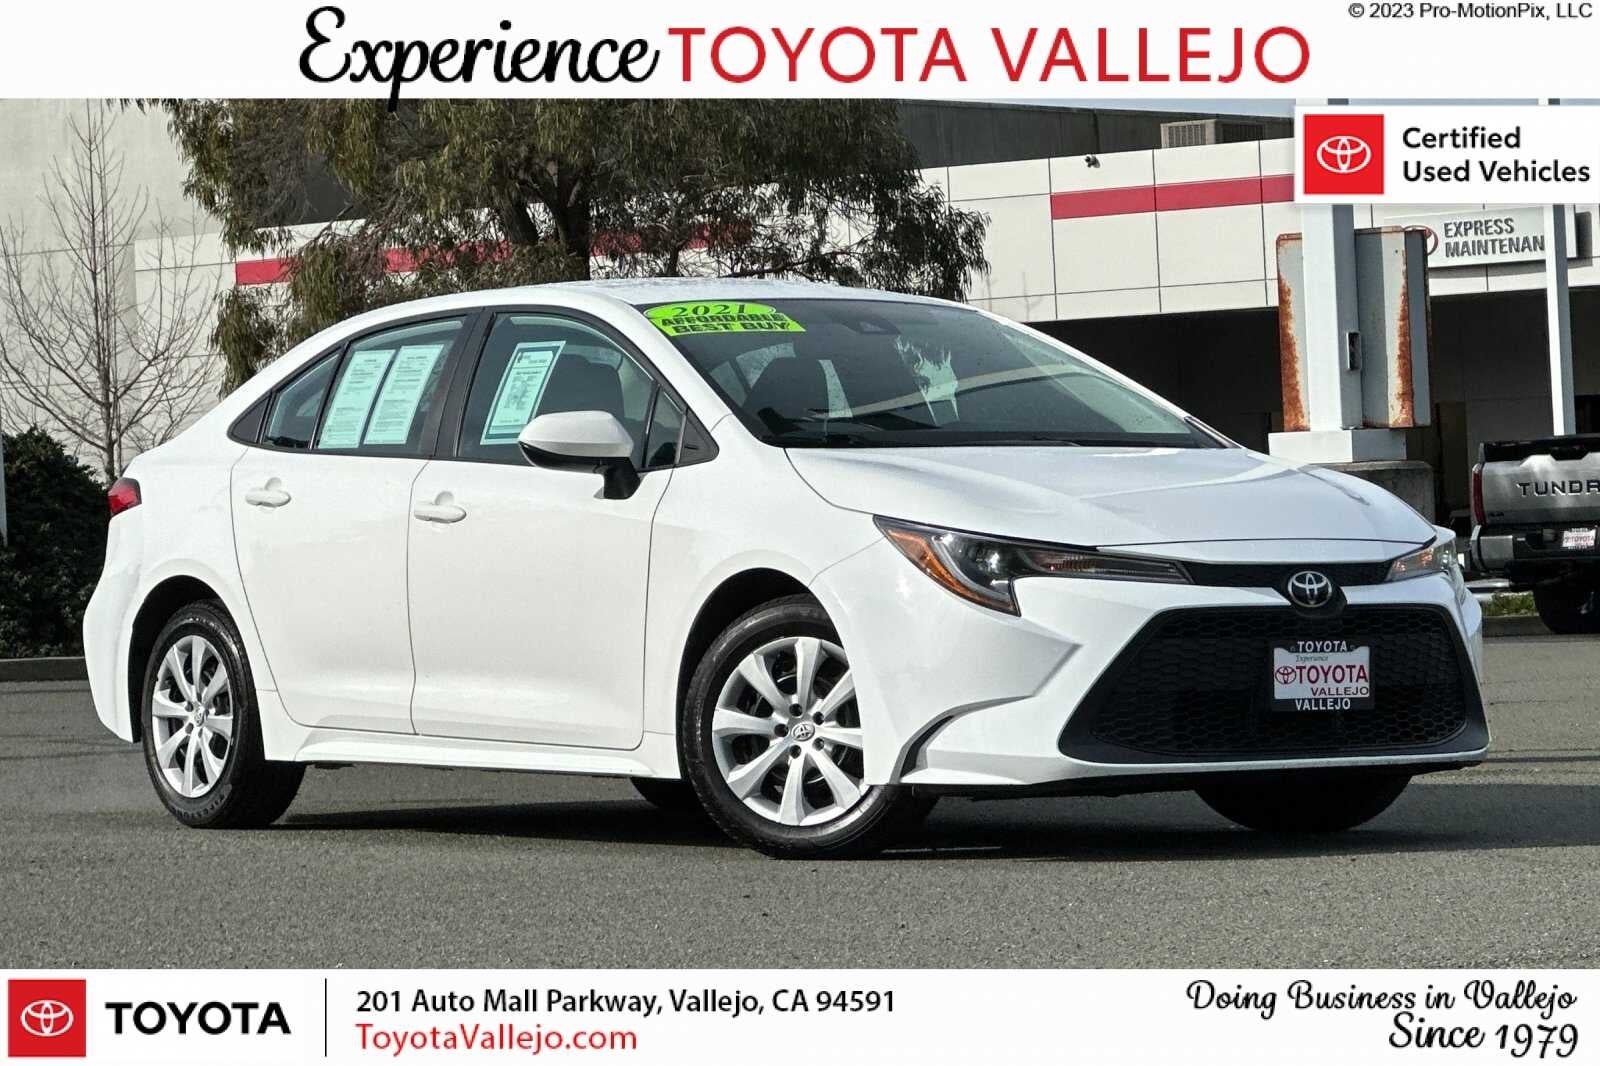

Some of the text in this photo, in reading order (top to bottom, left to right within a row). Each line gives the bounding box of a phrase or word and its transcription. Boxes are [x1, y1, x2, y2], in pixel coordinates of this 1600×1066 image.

[1443, 217, 1515, 238] EXPRESS
[1445, 235, 1546, 258] MAINTENAN
[671, 304, 746, 317] 2021
[661, 313, 785, 327] AFFORDABLE
[671, 320, 790, 333] BEST BUY
[1297, 641, 1348, 652] TOYOTA
[1295, 665, 1369, 684] TOYOTA
[1311, 687, 1369, 697] VALLEJO
[1295, 699, 1351, 711] VALLEJO
